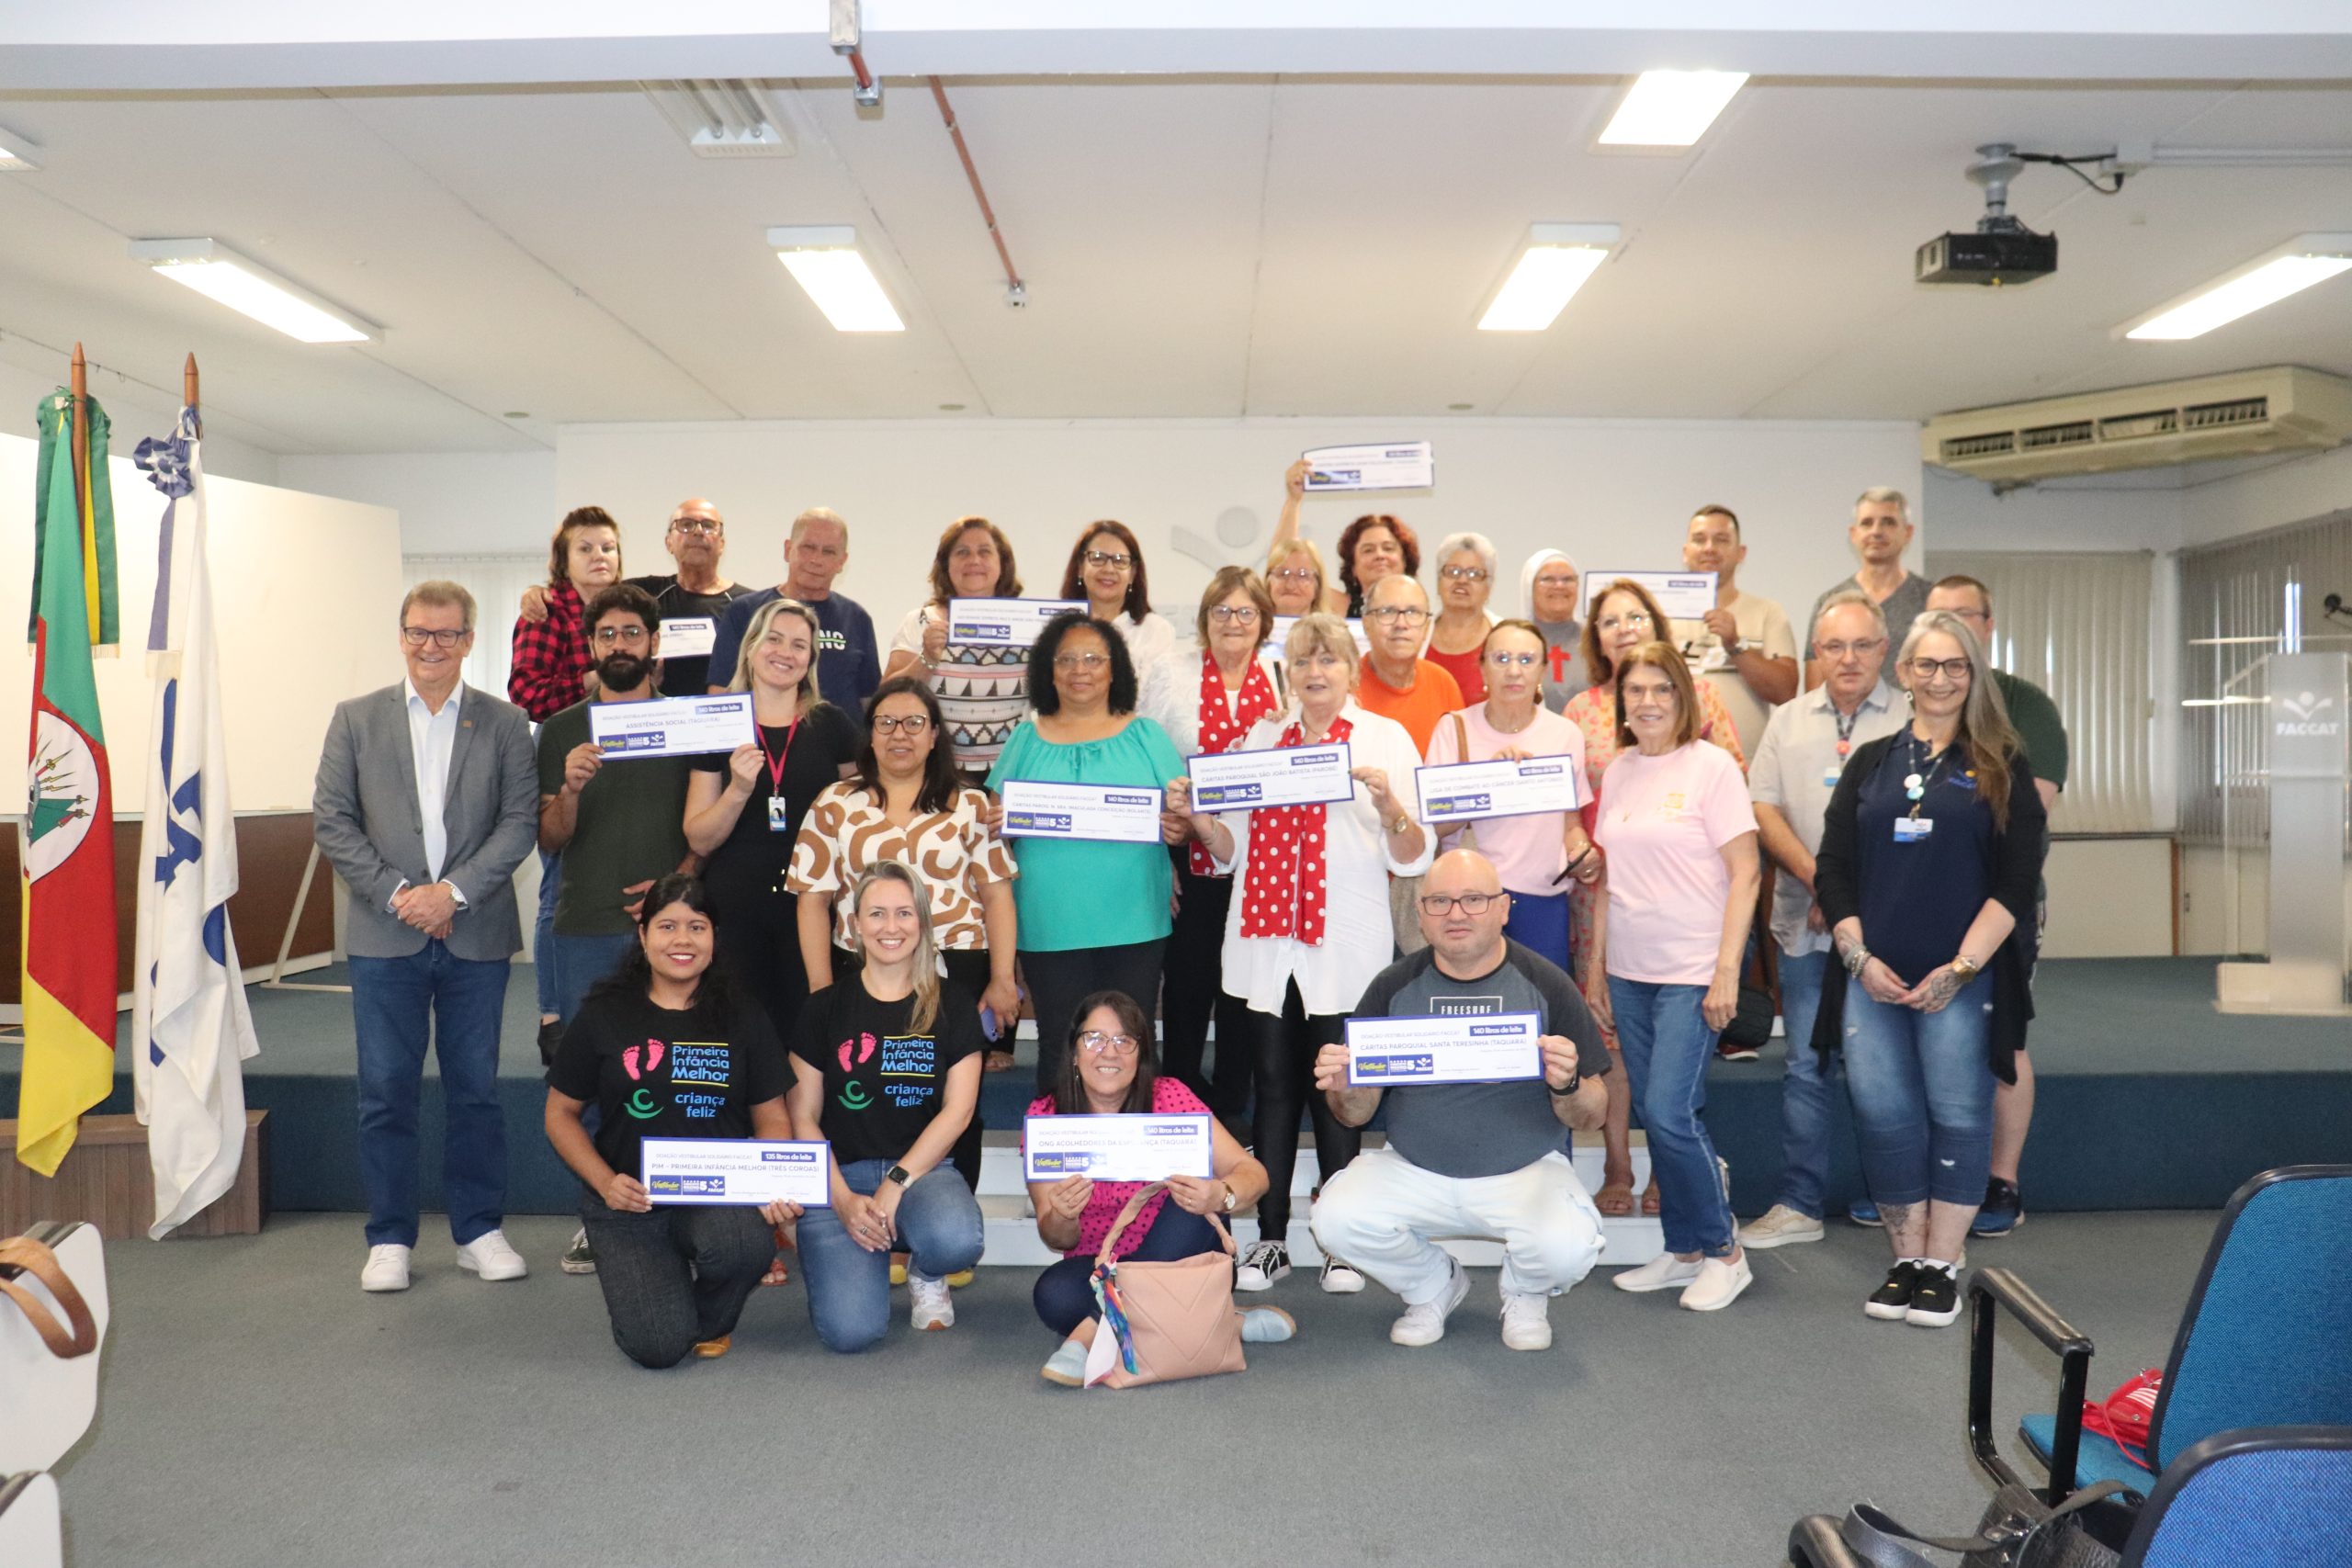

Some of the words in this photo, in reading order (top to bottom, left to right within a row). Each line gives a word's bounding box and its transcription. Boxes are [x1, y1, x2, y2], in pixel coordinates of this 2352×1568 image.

[626, 721, 663, 729] ASSISTÊNCIA
[2277, 722, 2339, 735] FACCAT
[1441, 1005, 1492, 1014] FREESURF
[883, 1039, 934, 1050] Primeira
[1389, 1042, 1428, 1050] PAROQUIAL
[1490, 1038, 1527, 1046] (TAQUARA)
[673, 1045, 729, 1057] Primeira
[882, 1049, 934, 1061] Infância
[672, 1055, 729, 1069] Infância
[881, 1059, 934, 1073] Melhor
[1407, 1060, 1415, 1071] 5
[672, 1066, 729, 1082] Melhor
[885, 1084, 934, 1099] criança
[674, 1092, 726, 1108] criança
[896, 1096, 924, 1107] feliz
[686, 1106, 717, 1118] feliz
[700, 1181, 707, 1191] 5
